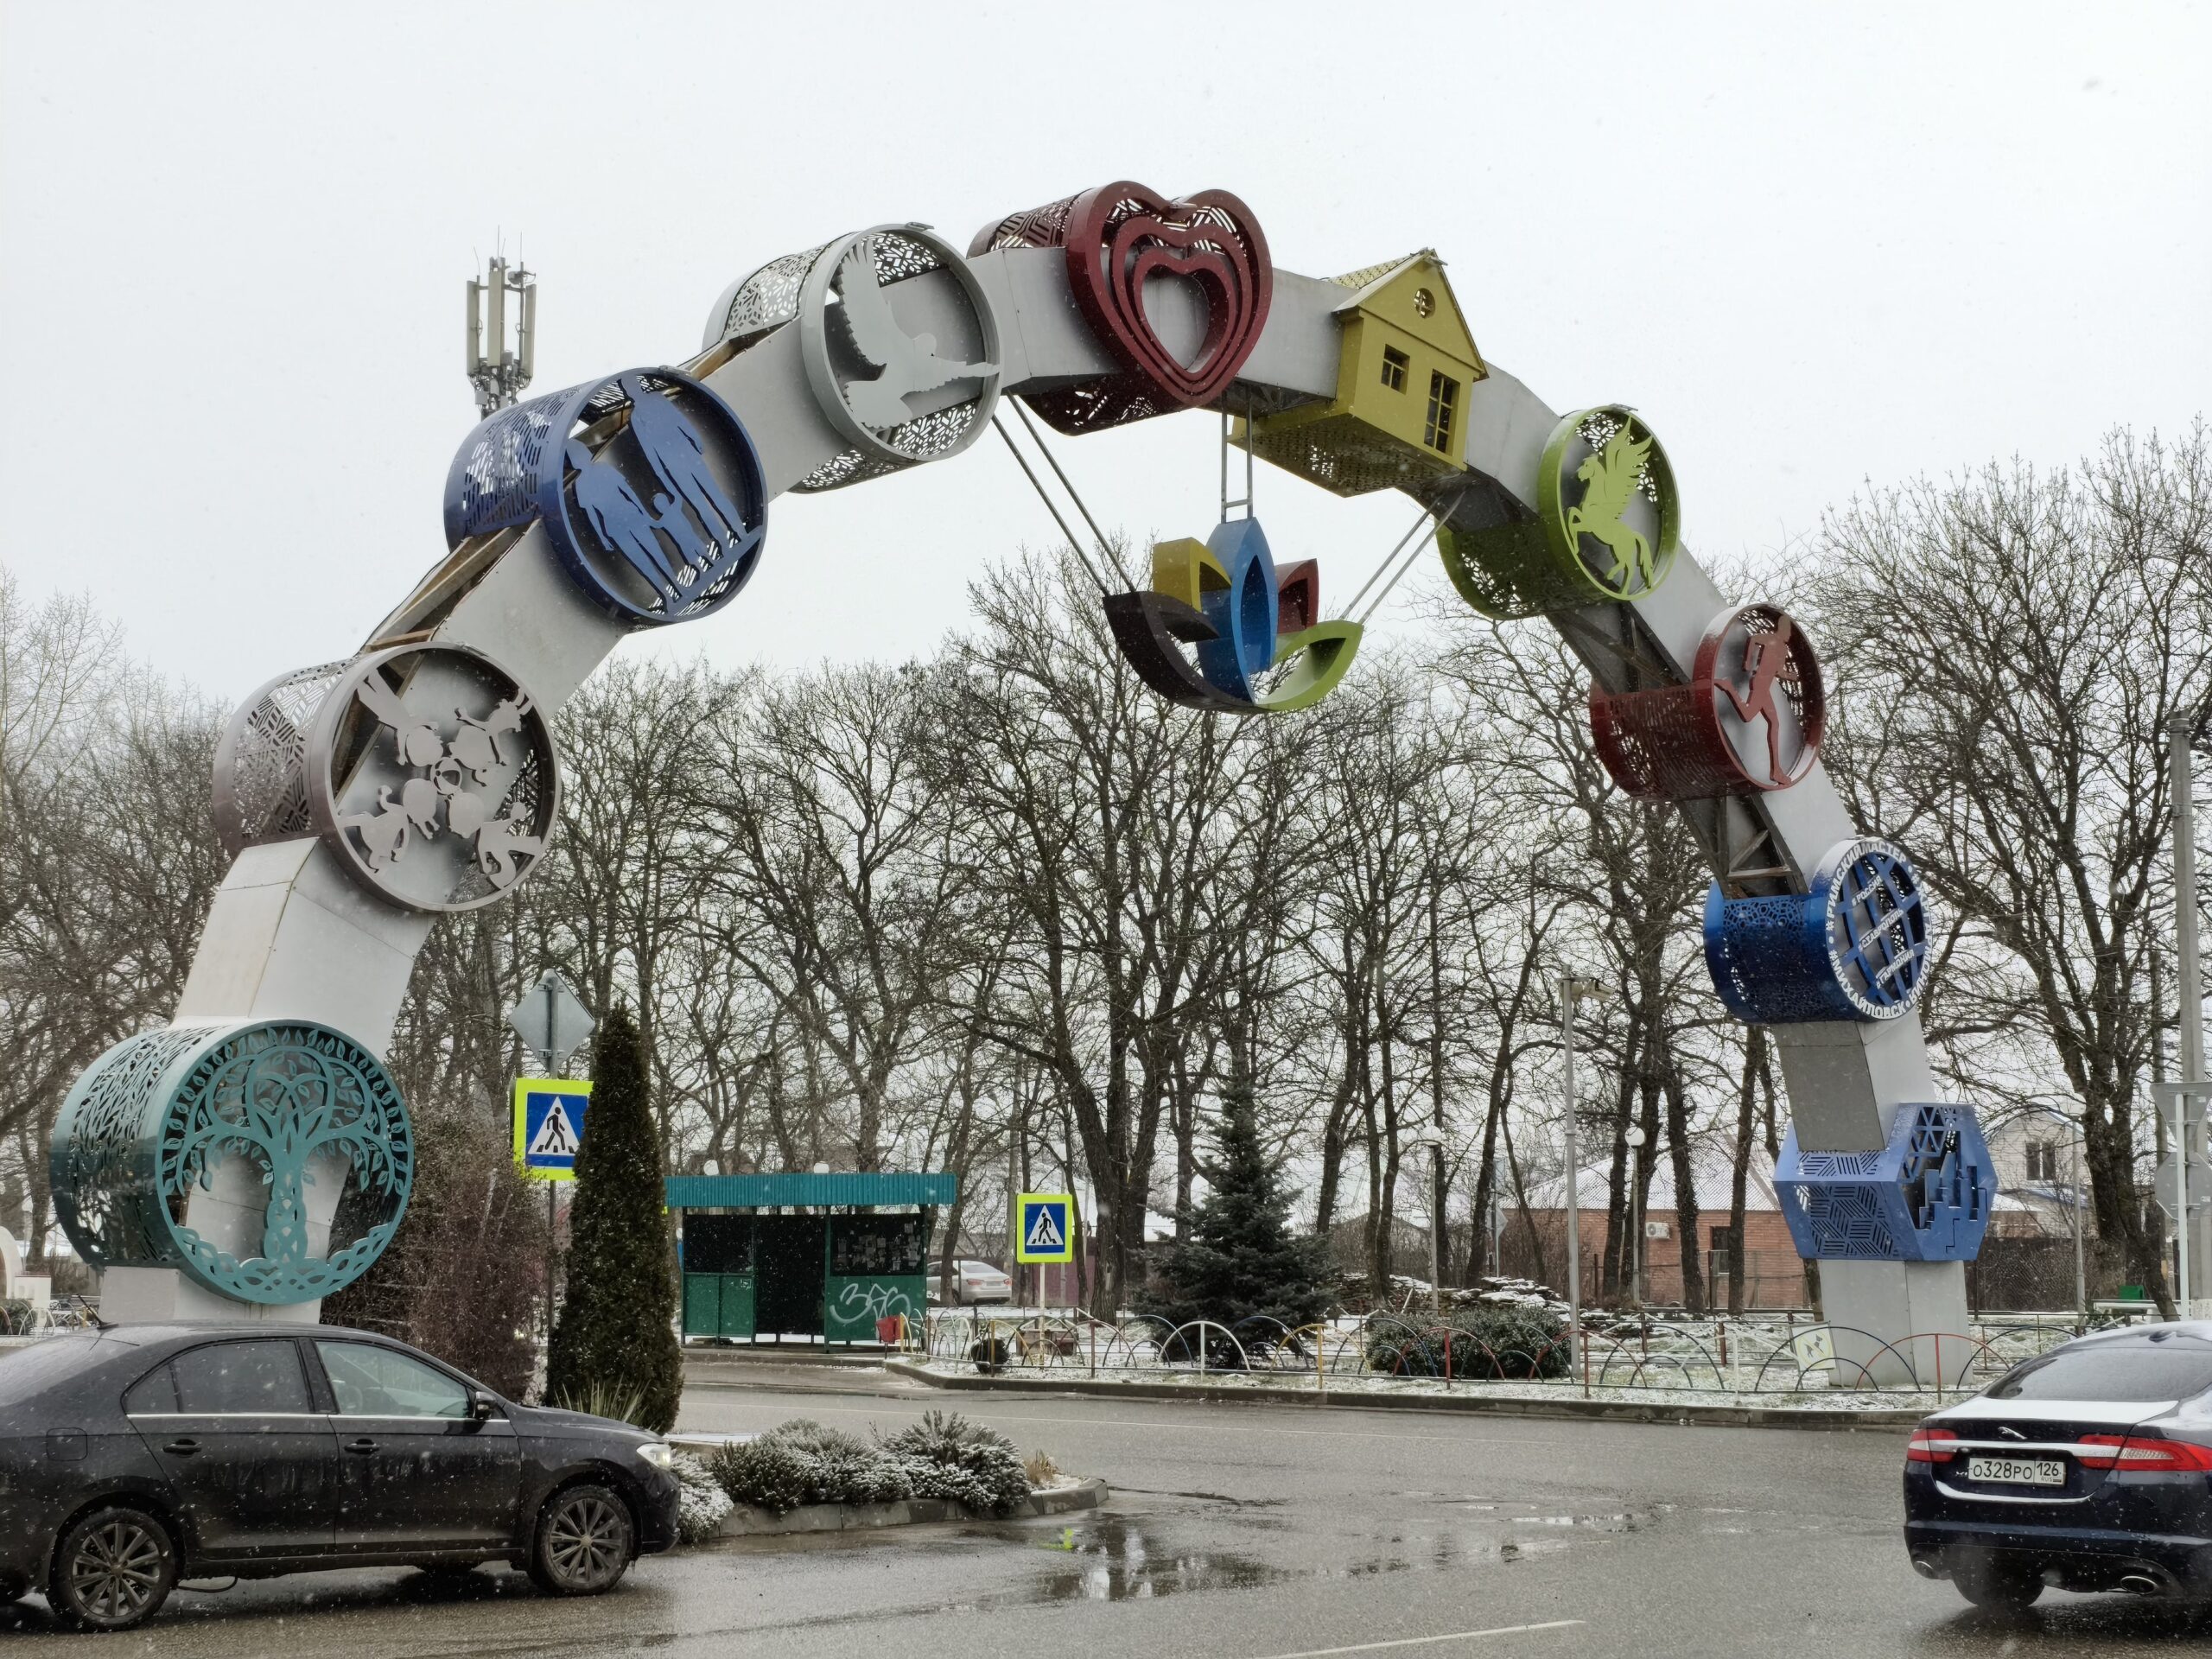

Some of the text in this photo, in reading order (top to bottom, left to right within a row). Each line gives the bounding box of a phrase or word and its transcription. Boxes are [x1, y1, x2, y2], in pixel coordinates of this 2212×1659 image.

[1852, 875, 1882, 906] #РОССИЯ
[1859, 909, 1904, 951] #СТАВРОПОЛЬ
[1828, 950, 1907, 1018] #МИХАЙЛОВСК
[1876, 950, 1915, 988] #ГАРМОНИЯ
[2037, 1463, 2059, 1477] 126
